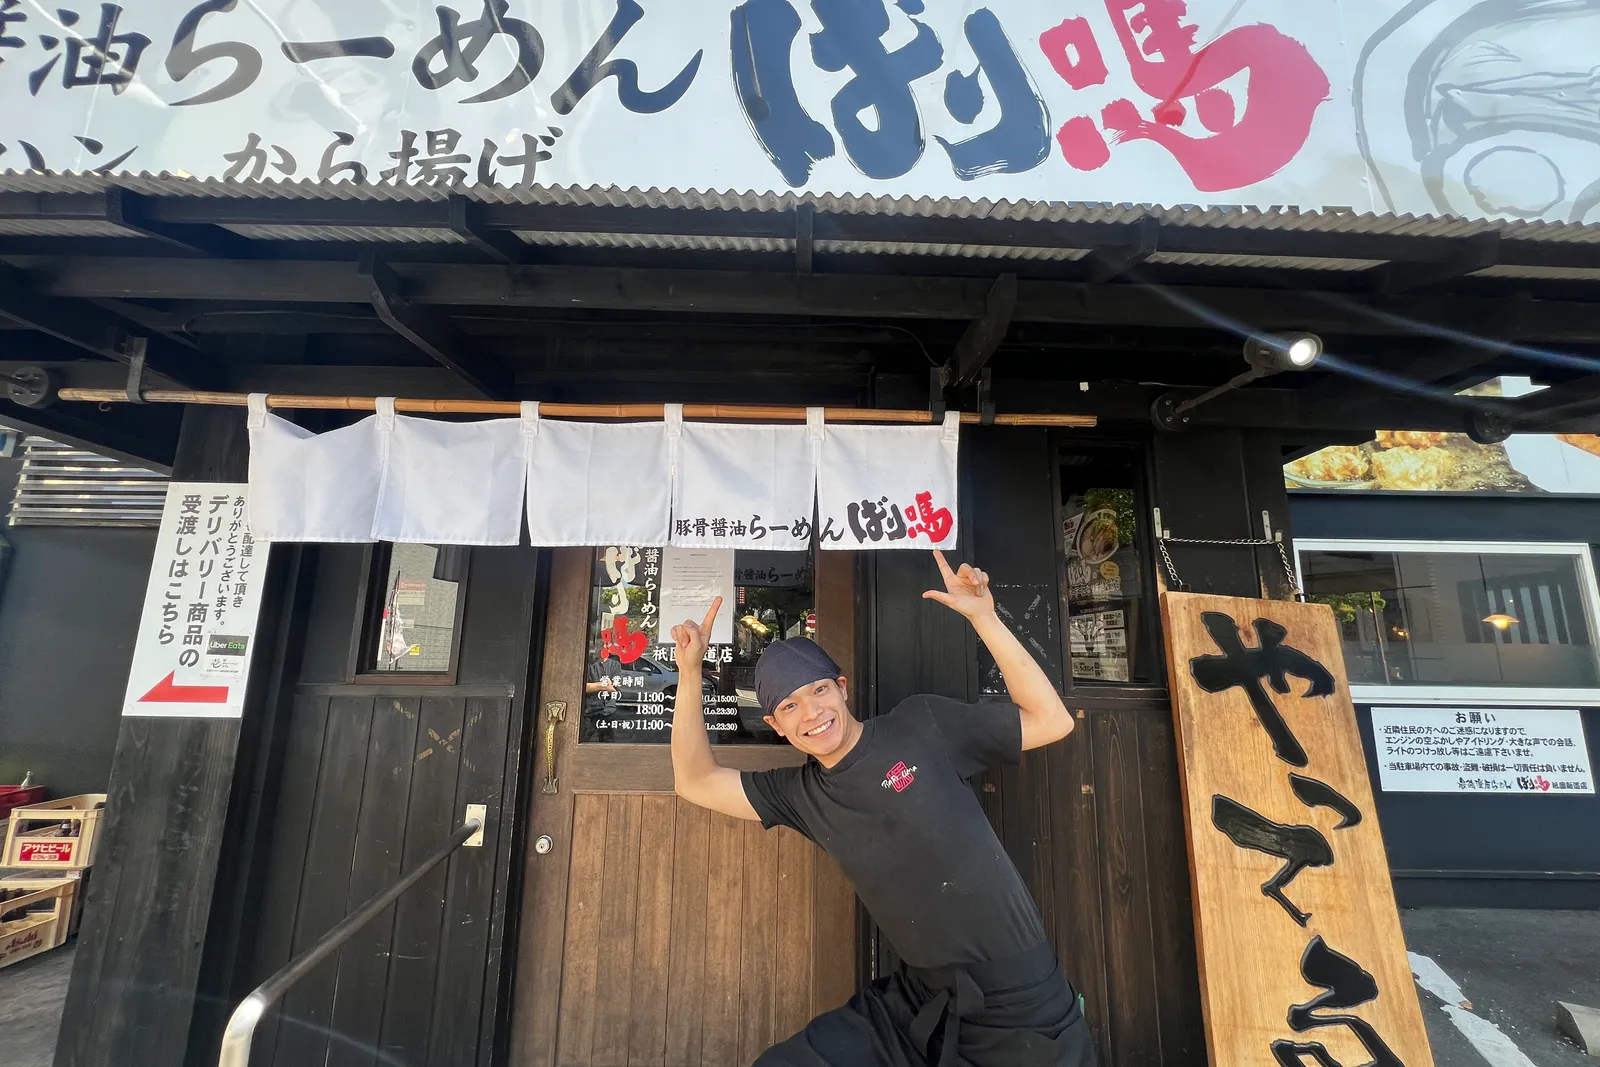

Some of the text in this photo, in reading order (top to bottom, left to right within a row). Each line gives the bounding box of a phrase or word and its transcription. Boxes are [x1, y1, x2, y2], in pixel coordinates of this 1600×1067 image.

[0, 0, 703, 114] 油らーめん
[223, 126, 564, 187] から揚げ
[674, 514, 845, 542] 豚骨醤油らーめん
[157, 494, 202, 645] 受渡しはこちら
[179, 494, 229, 668] デリバリー商品の
[214, 495, 245, 626] ありがとうございます。
[232, 524, 255, 608] 配達して頂き
[640, 548, 660, 629] 醤油らーめん
[210, 641, 228, 649] Uber
[652, 646, 734, 663] 祇道店
[597, 691, 622, 701] (平日)
[599, 675, 645, 688] 営業時間
[1455, 711, 1496, 724] お願い
[22, 843, 71, 853] アサヒビール
